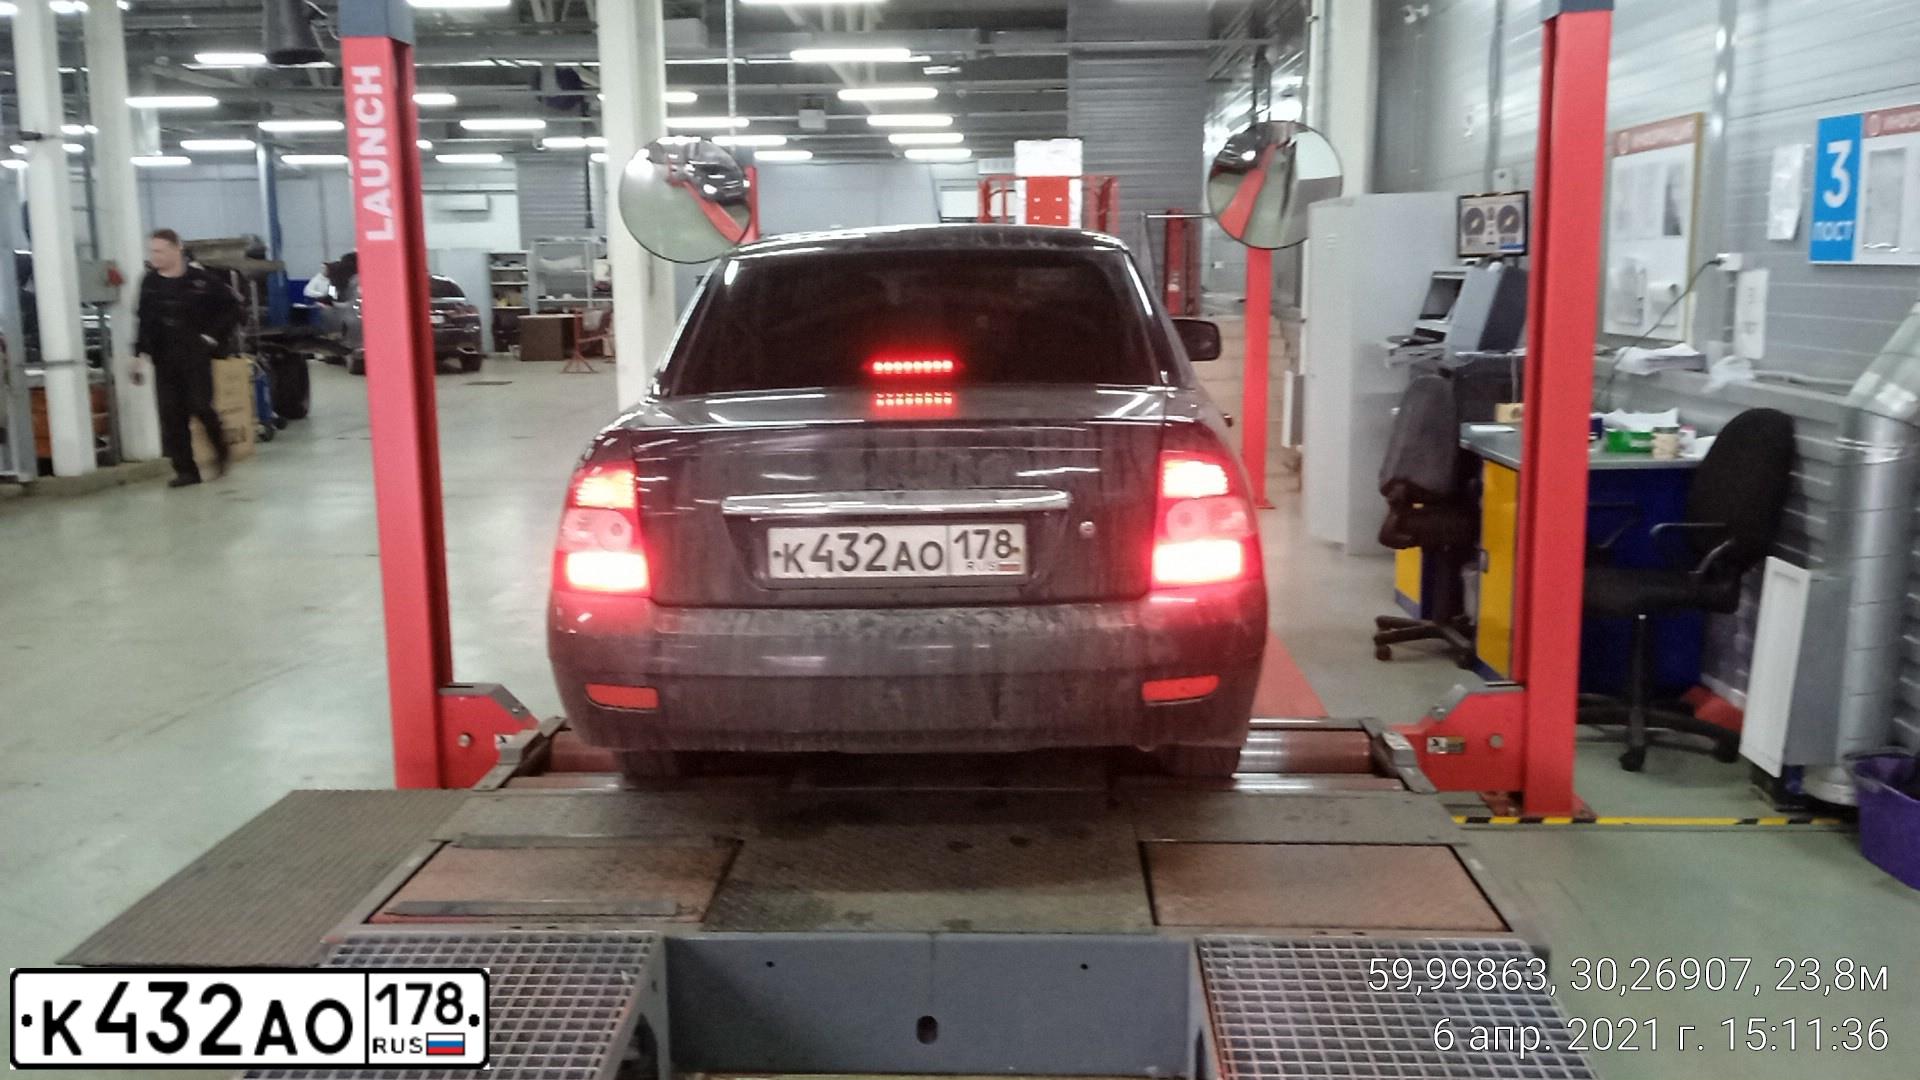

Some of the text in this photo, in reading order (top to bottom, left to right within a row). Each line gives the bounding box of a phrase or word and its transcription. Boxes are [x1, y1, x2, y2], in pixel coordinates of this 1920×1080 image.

[351, 65, 395, 241] LAUNCH
[1822, 139, 1854, 209] 3
[953, 528, 1013, 560] 178
